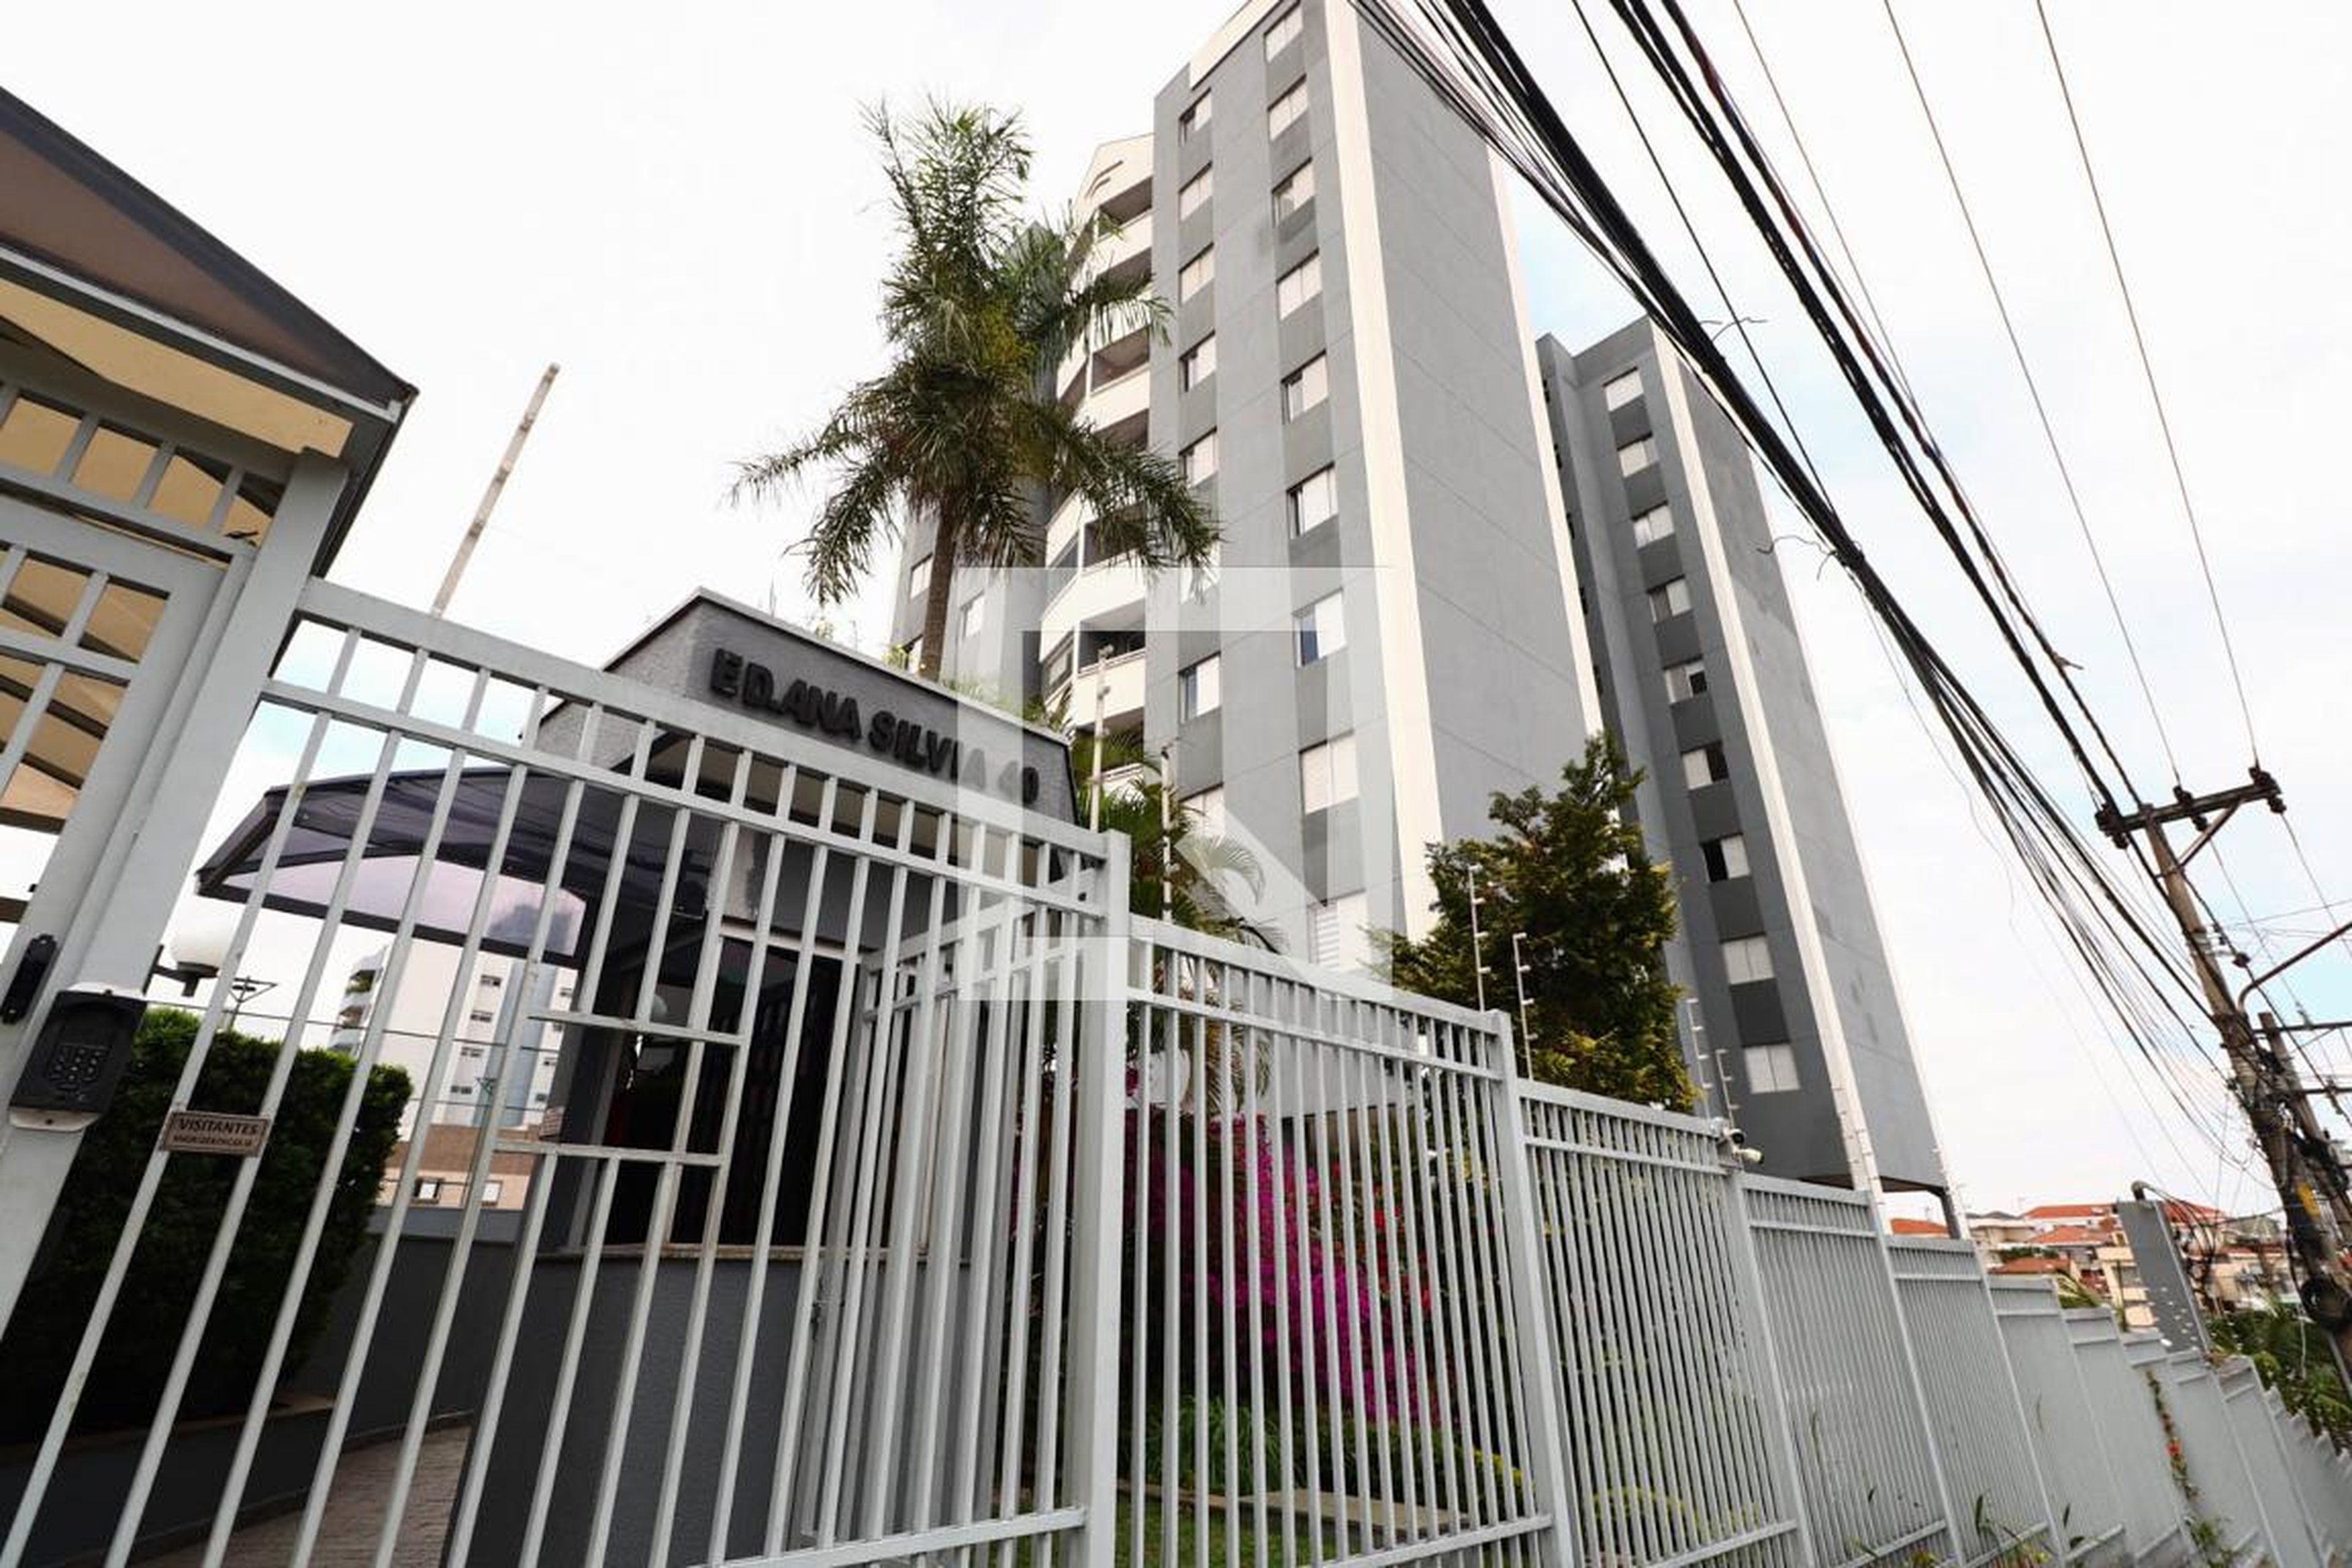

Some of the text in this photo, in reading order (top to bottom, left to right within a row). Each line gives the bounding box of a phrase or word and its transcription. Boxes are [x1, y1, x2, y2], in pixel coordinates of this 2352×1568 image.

[867, 710, 987, 791] SILVIA
[998, 760, 1039, 805] 40
[179, 1118, 258, 1134] VISITANTES
